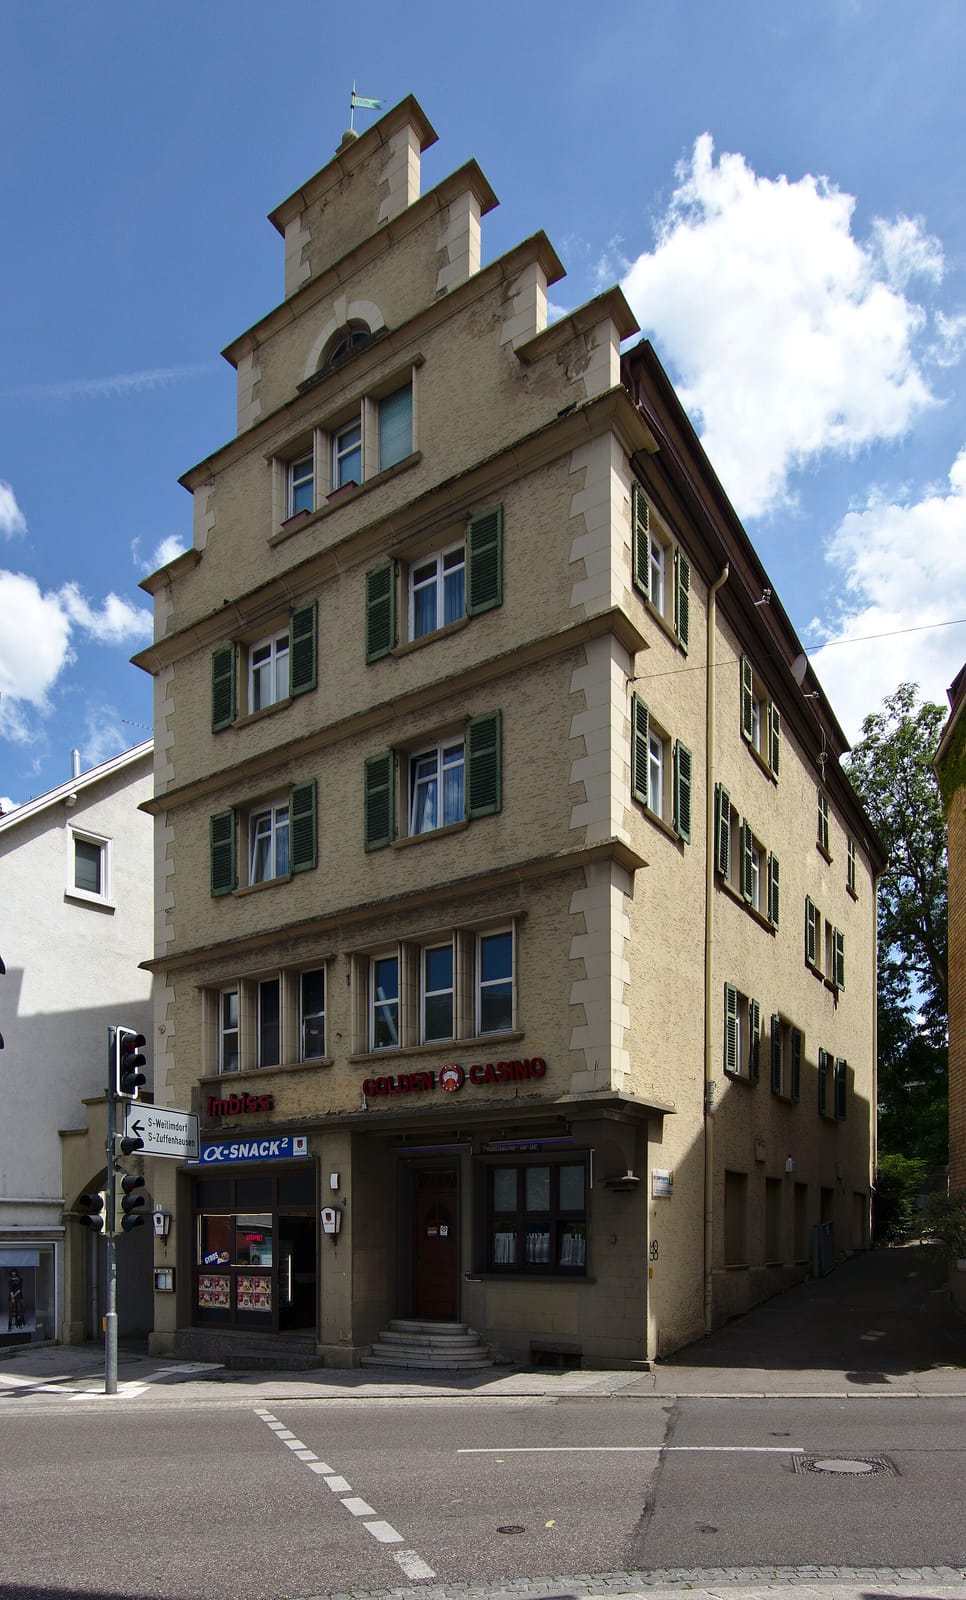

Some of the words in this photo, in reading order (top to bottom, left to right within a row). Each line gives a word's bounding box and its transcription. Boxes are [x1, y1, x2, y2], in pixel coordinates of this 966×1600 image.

[362, 1071, 434, 1098] GOLDEN
[469, 1057, 545, 1085] CASINO
[207, 1092, 273, 1116] Imbiss
[148, 1117, 188, 1132] S-Weilimdorf
[148, 1132, 196, 1147] S-Zuffenhausen
